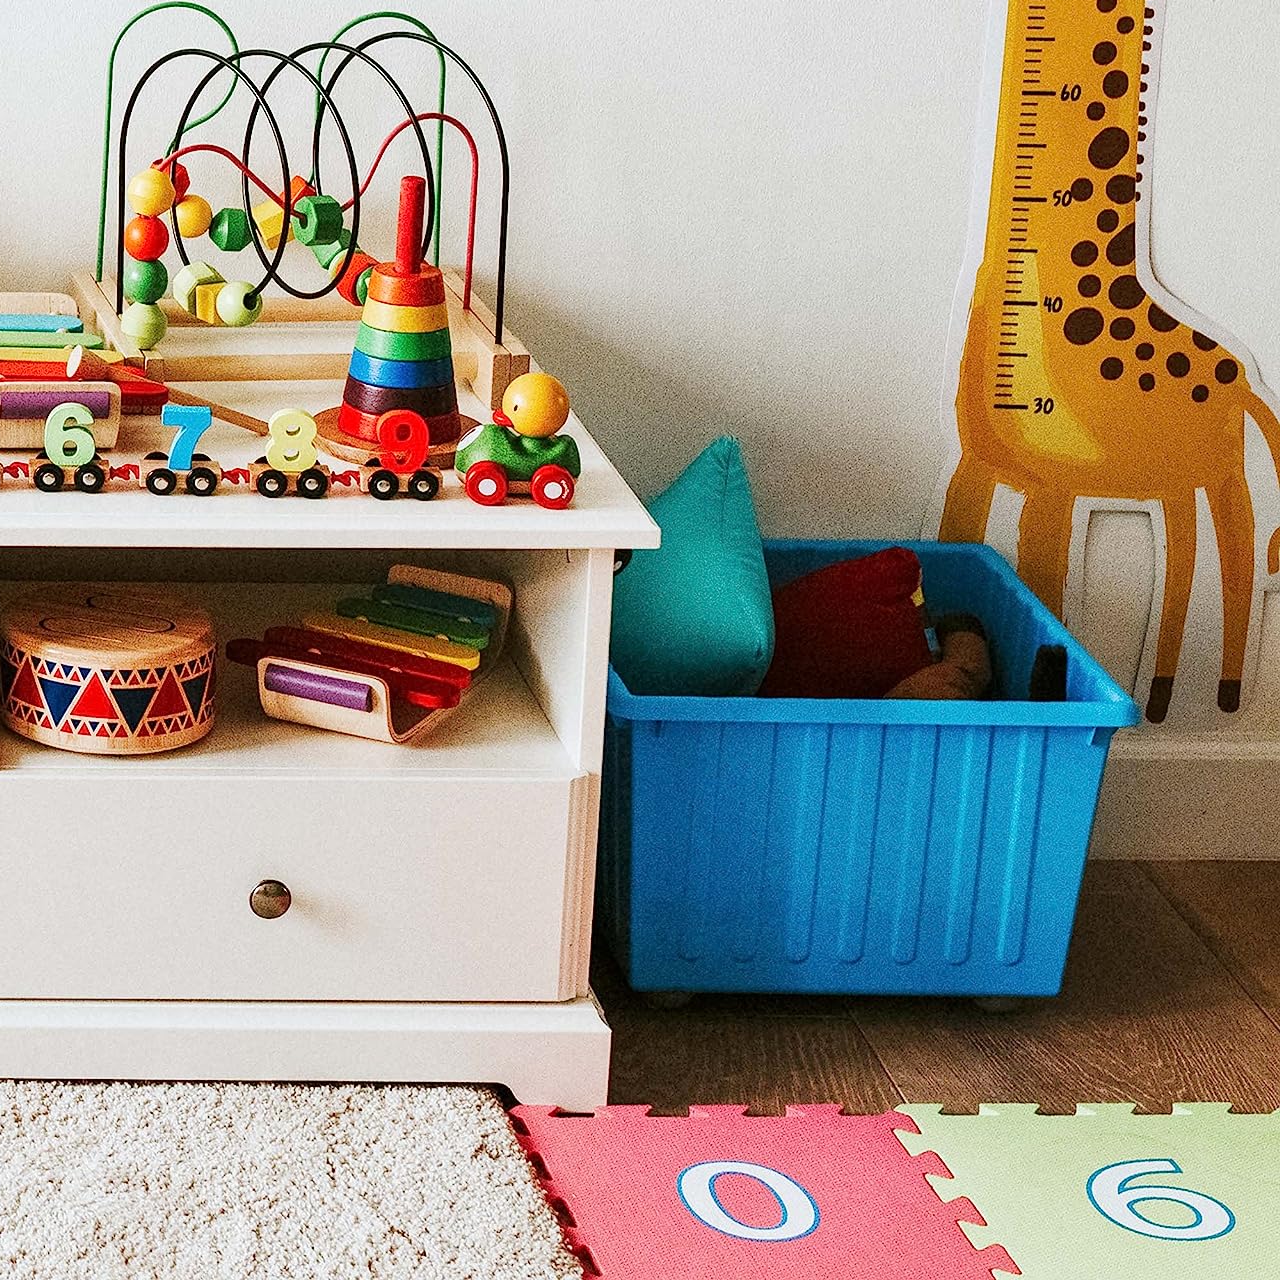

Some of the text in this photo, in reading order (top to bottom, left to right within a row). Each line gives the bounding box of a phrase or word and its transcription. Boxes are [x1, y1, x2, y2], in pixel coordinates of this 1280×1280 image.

[1060, 83, 1082, 102] 60
[1052, 189, 1072, 207] 50
[1043, 296, 1064, 314] 40
[43, 402, 95, 467] 6
[1034, 397, 1055, 415] 30
[162, 406, 213, 471] 7
[267, 408, 320, 472] 8
[376, 409, 430, 472] 9
[676, 1160, 822, 1243] 0
[1085, 1158, 1238, 1243] 6
